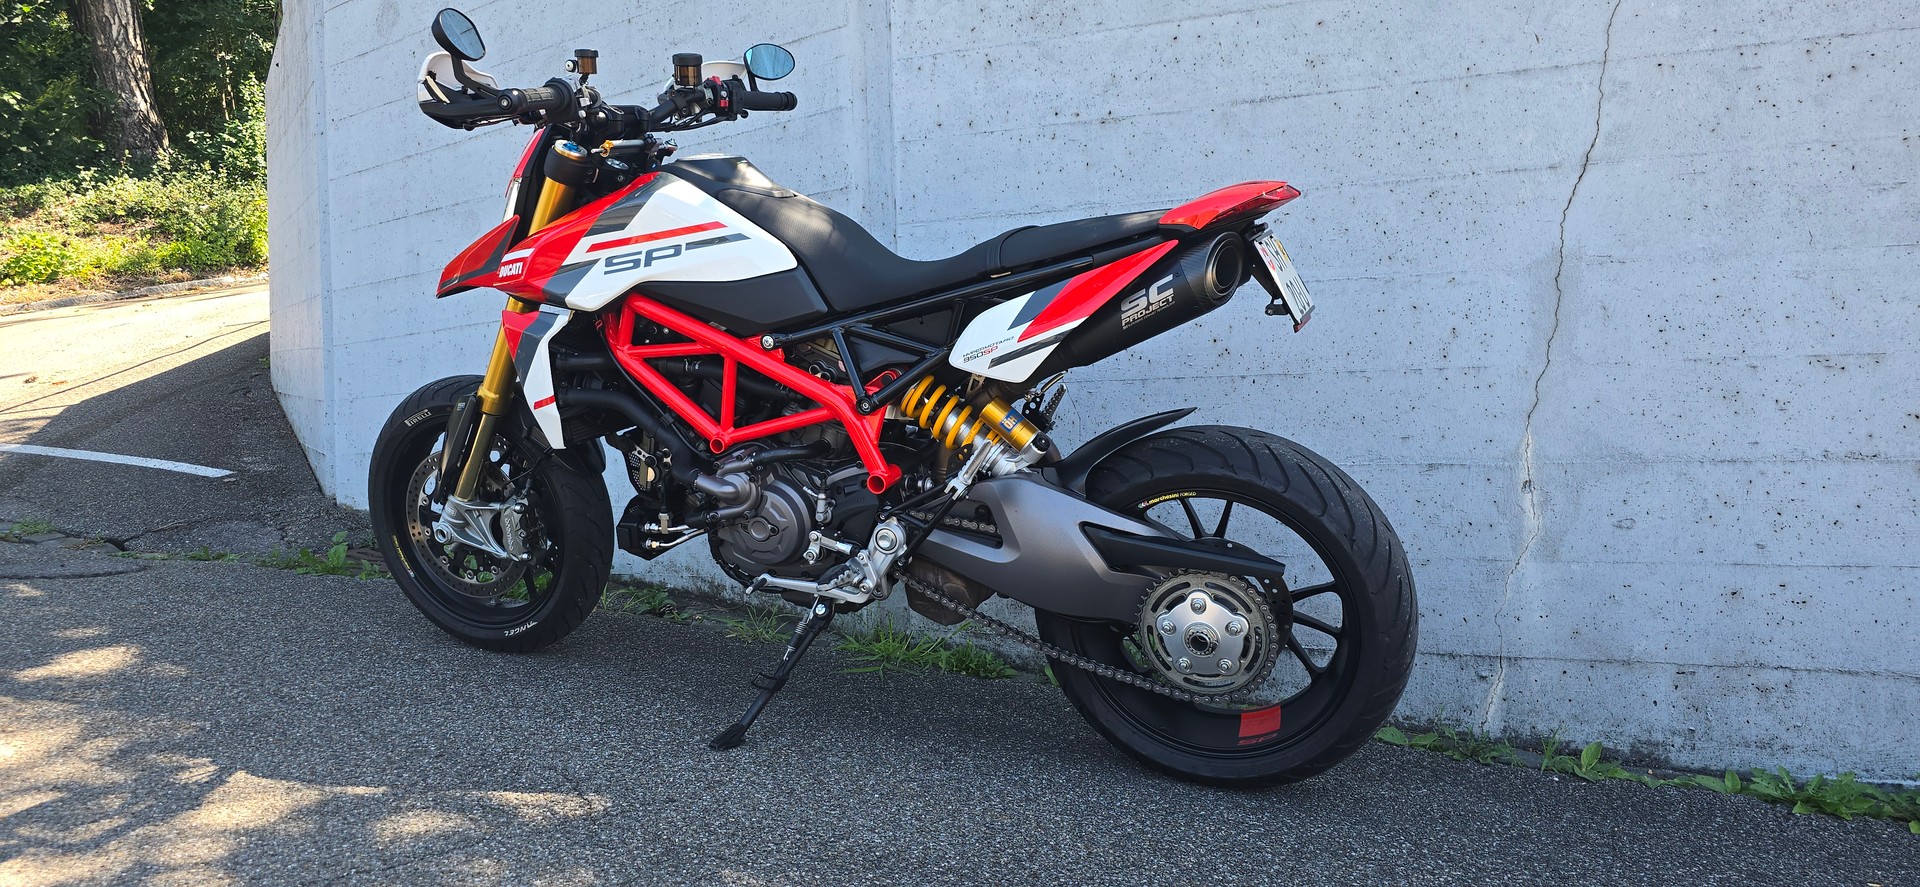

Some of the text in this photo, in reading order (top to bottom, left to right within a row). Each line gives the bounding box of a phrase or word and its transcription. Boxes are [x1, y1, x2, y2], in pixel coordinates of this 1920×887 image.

[498, 261, 524, 278] DUCATI
[603, 244, 682, 275] SP
[1120, 273, 1174, 320] SC
[1121, 294, 1175, 327] PROJECT
[404, 408, 432, 427] PIRELLI
[503, 620, 538, 637] ANGEL
